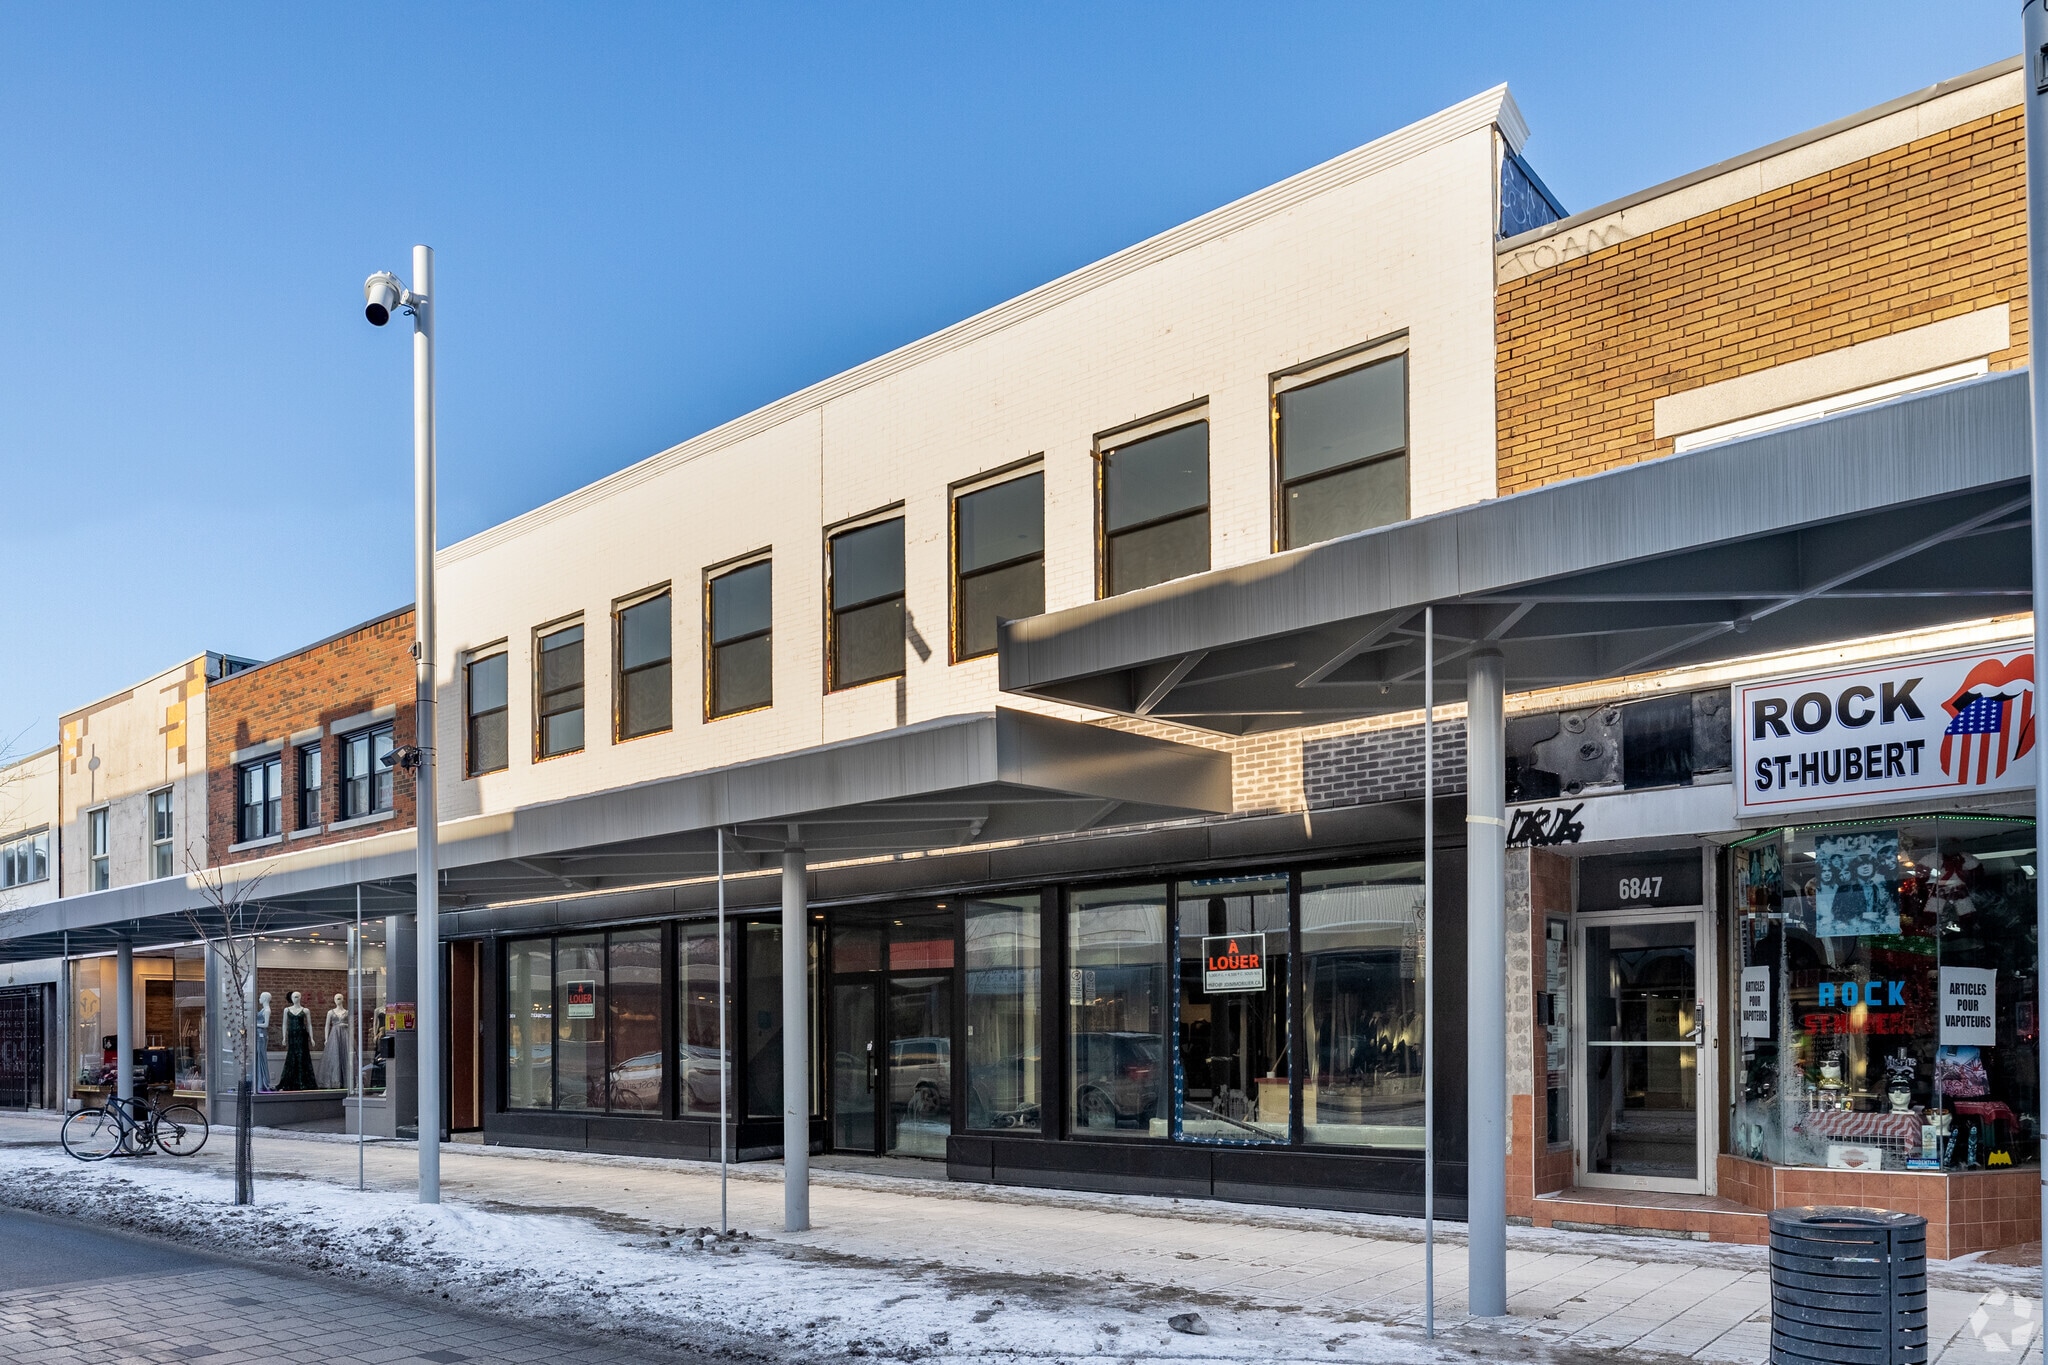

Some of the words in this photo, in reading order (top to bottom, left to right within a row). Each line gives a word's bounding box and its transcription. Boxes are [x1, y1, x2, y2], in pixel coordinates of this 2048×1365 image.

[1752, 677, 1925, 741] ROCK
[1754, 739, 1926, 792] ST-HUBERT
[1619, 876, 1663, 900] 6847
[1209, 954, 1259, 970] LOUER
[1745, 981, 1765, 992] ARTICLES
[1818, 980, 1906, 1006] ROCK
[1949, 983, 1987, 996] ARTICLES
[569, 994, 592, 1003] LOUER
[1749, 996, 1761, 1007] POUR
[1957, 999, 1979, 1011] POUR
[1743, 1010, 1767, 1021] VAPOTEURS
[1945, 1015, 1991, 1028] VAPOTEURS
